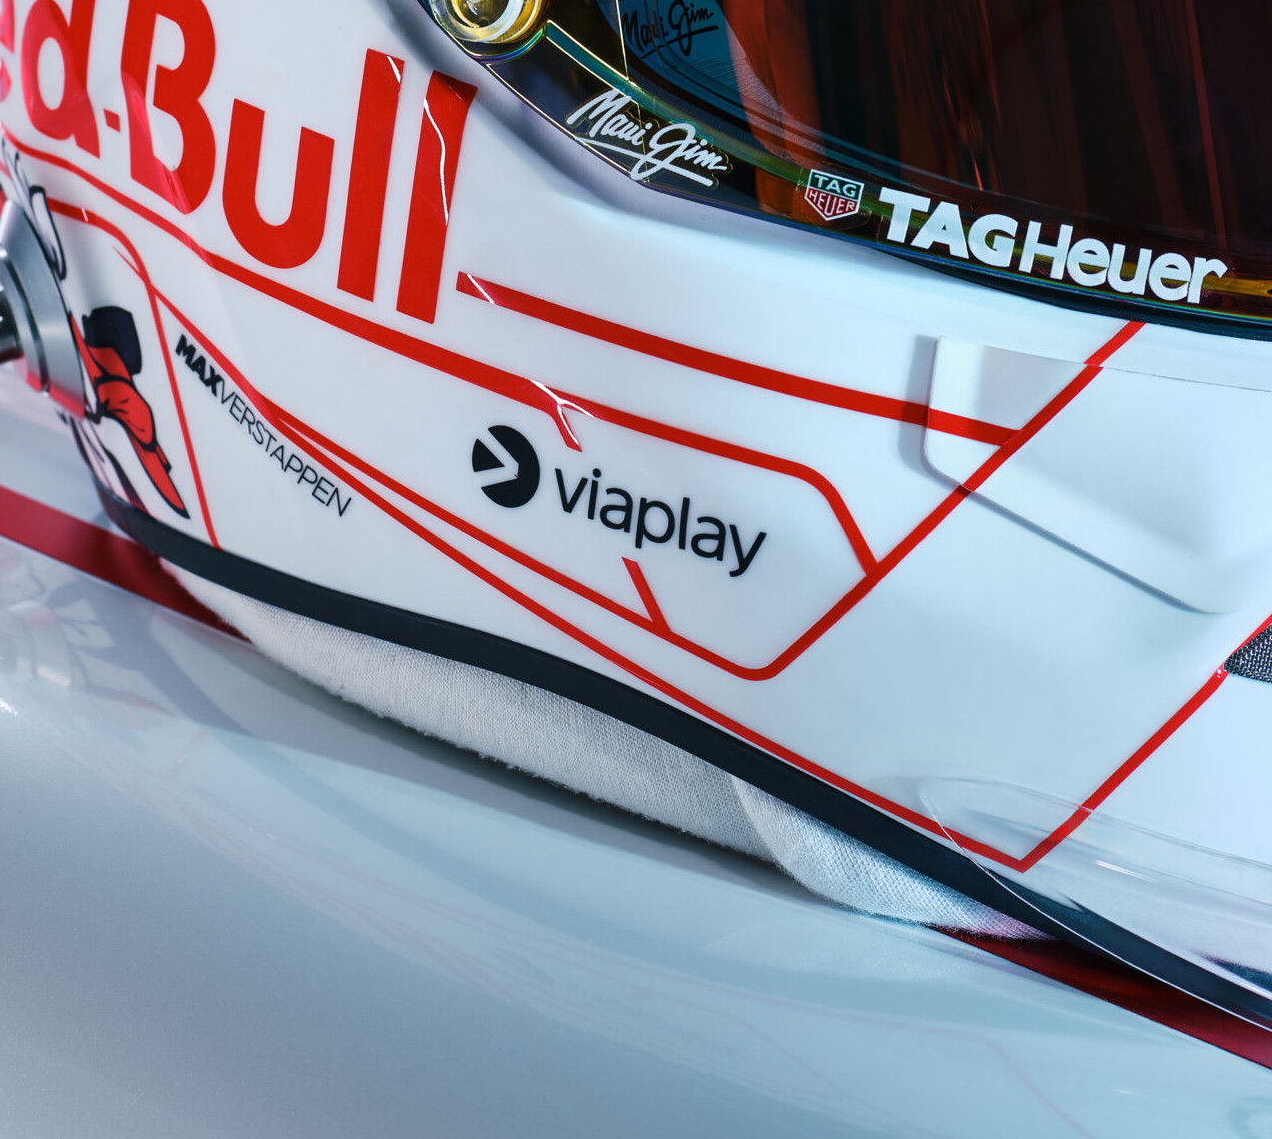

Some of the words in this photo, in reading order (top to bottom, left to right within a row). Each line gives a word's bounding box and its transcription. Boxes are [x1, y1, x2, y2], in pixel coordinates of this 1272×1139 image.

[565, 87, 653, 148] Maui
[808, 189, 856, 217] HEUER
[814, 174, 857, 198] TAG
[554, 466, 767, 578] viaplay
